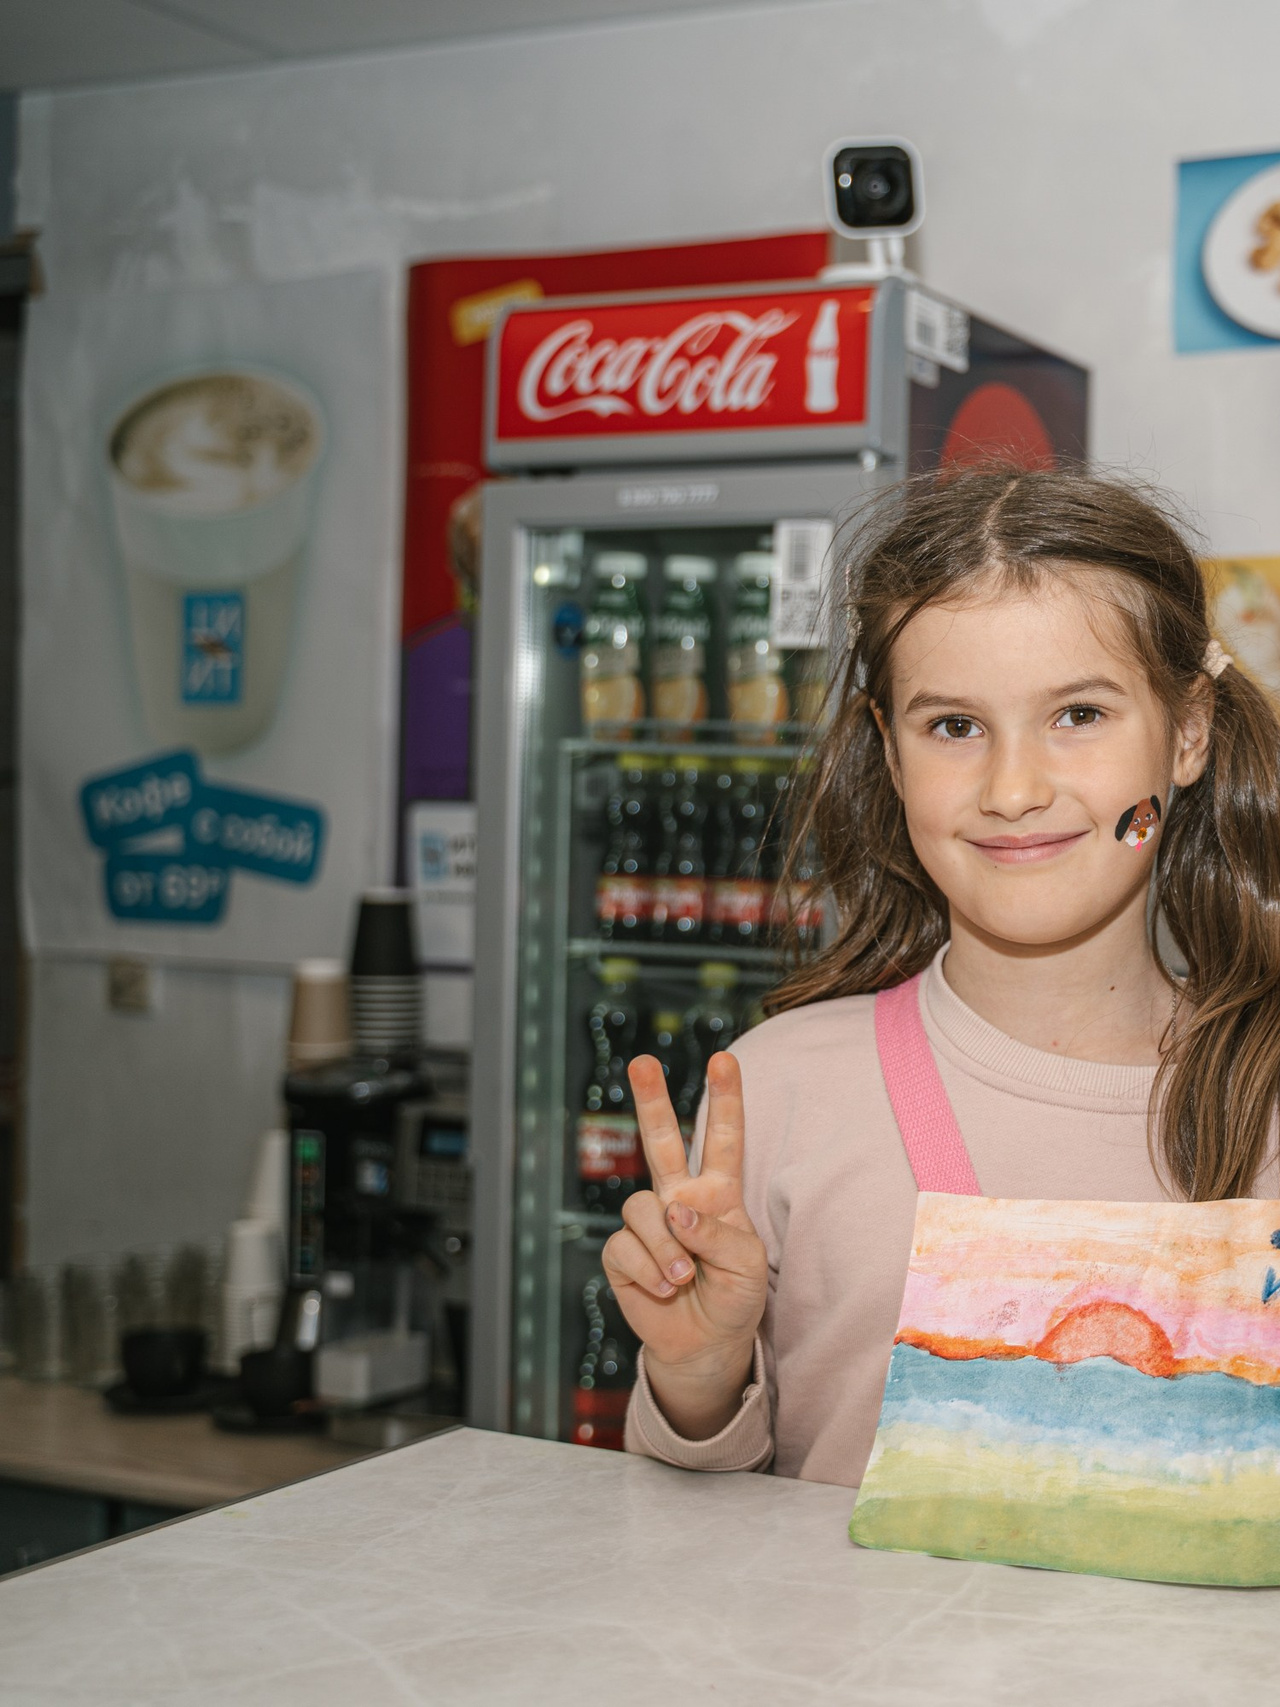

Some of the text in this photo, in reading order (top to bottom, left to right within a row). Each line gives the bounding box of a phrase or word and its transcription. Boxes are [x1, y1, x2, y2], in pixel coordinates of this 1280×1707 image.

[517, 307, 802, 422] Coca-Cola
[92, 771, 191, 828] Кофе
[194, 809, 313, 866] с собой
